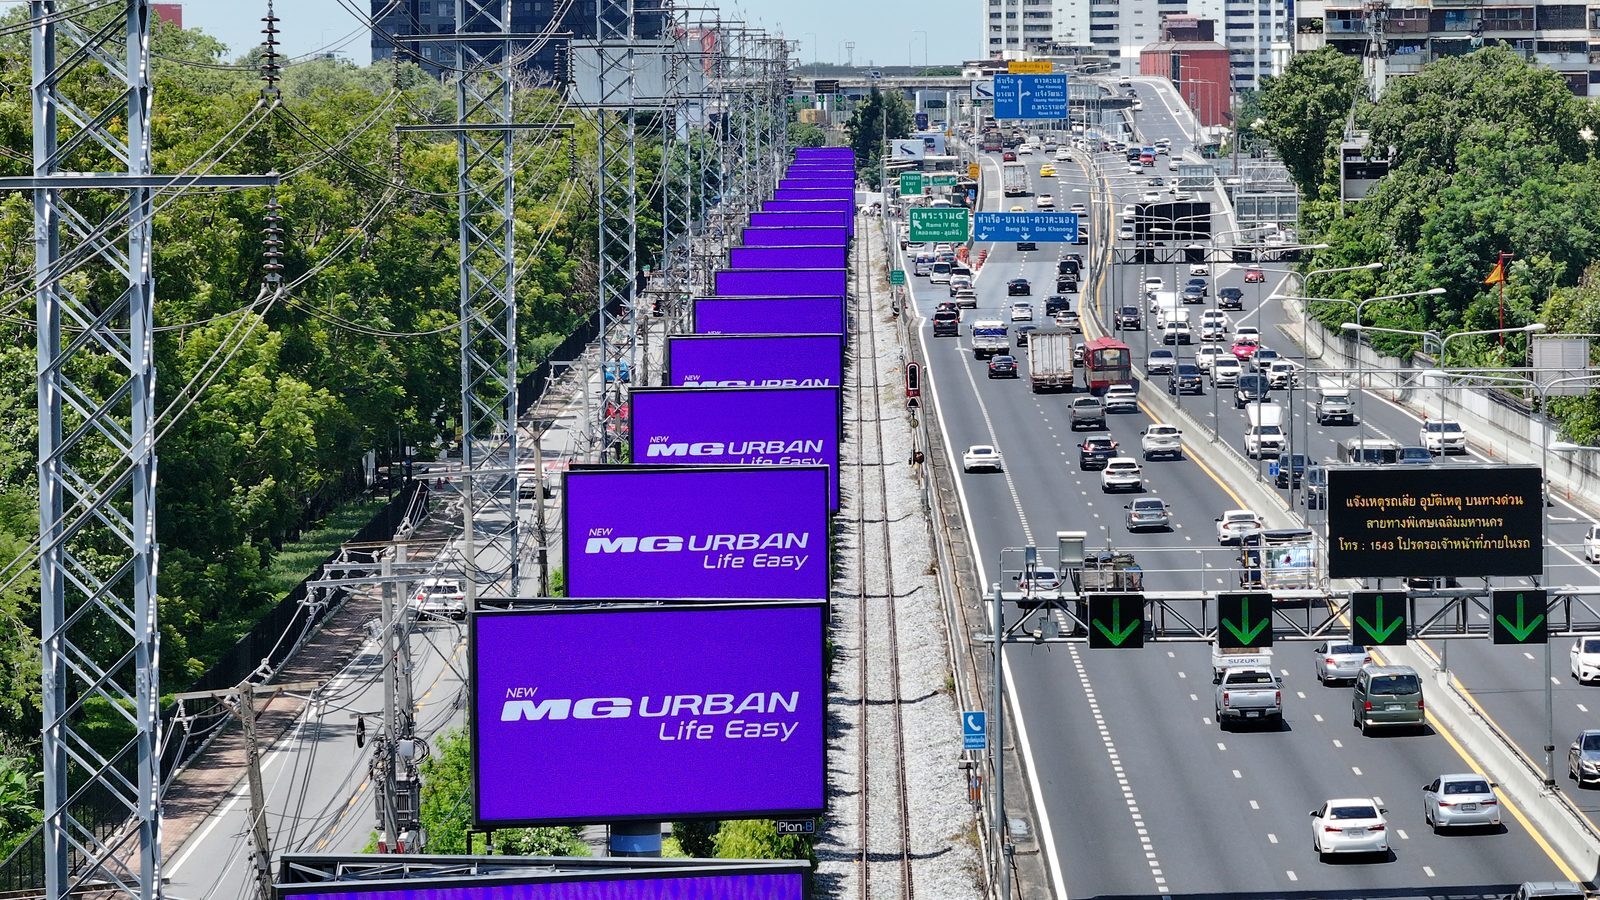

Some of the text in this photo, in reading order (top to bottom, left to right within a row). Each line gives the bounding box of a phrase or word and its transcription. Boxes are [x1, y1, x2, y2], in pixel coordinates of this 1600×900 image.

[647, 440, 823, 457] MG URBAN
[1466, 494, 1524, 506] บนทางด่วน
[1366, 515, 1504, 529] สายทางพิเศษเฉลิมมหานคร
[588, 528, 613, 536] NEW
[585, 532, 809, 554] MG URBAN
[1339, 537, 1358, 551] โทร
[1370, 541, 1394, 551] 1543
[1397, 533, 1531, 550] โปรดรอเจ้าหน้าที่ภายในรถ
[703, 553, 809, 570] Life Easy
[505, 687, 538, 698] NEW
[500, 691, 800, 721] MG URBAN
[659, 719, 799, 742] Life Easy
